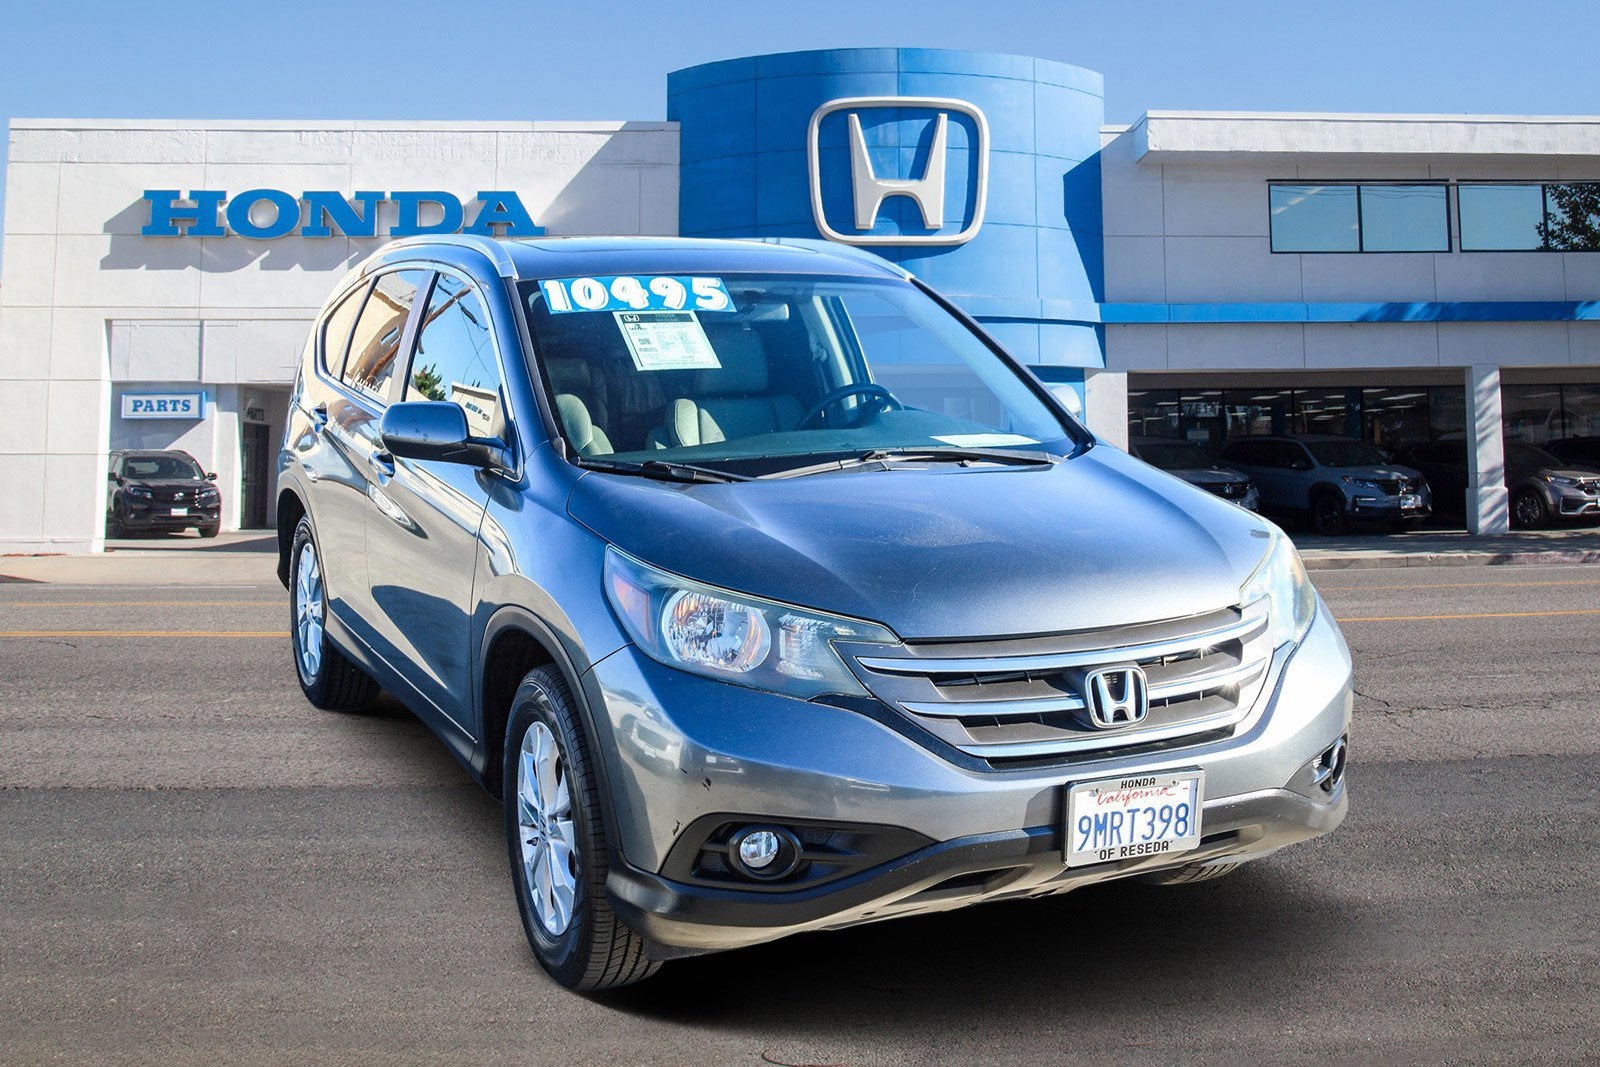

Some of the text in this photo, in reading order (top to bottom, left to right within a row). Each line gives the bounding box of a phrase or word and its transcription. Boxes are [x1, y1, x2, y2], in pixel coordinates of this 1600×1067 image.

[141, 189, 547, 239] HONDA
[543, 276, 729, 310] 10495
[132, 399, 191, 413] PARTS
[1120, 777, 1156, 790] HONDA
[1097, 786, 1175, 807] California
[1078, 802, 1190, 851] 9MRT398
[1099, 841, 1169, 861] OF RESEDA
